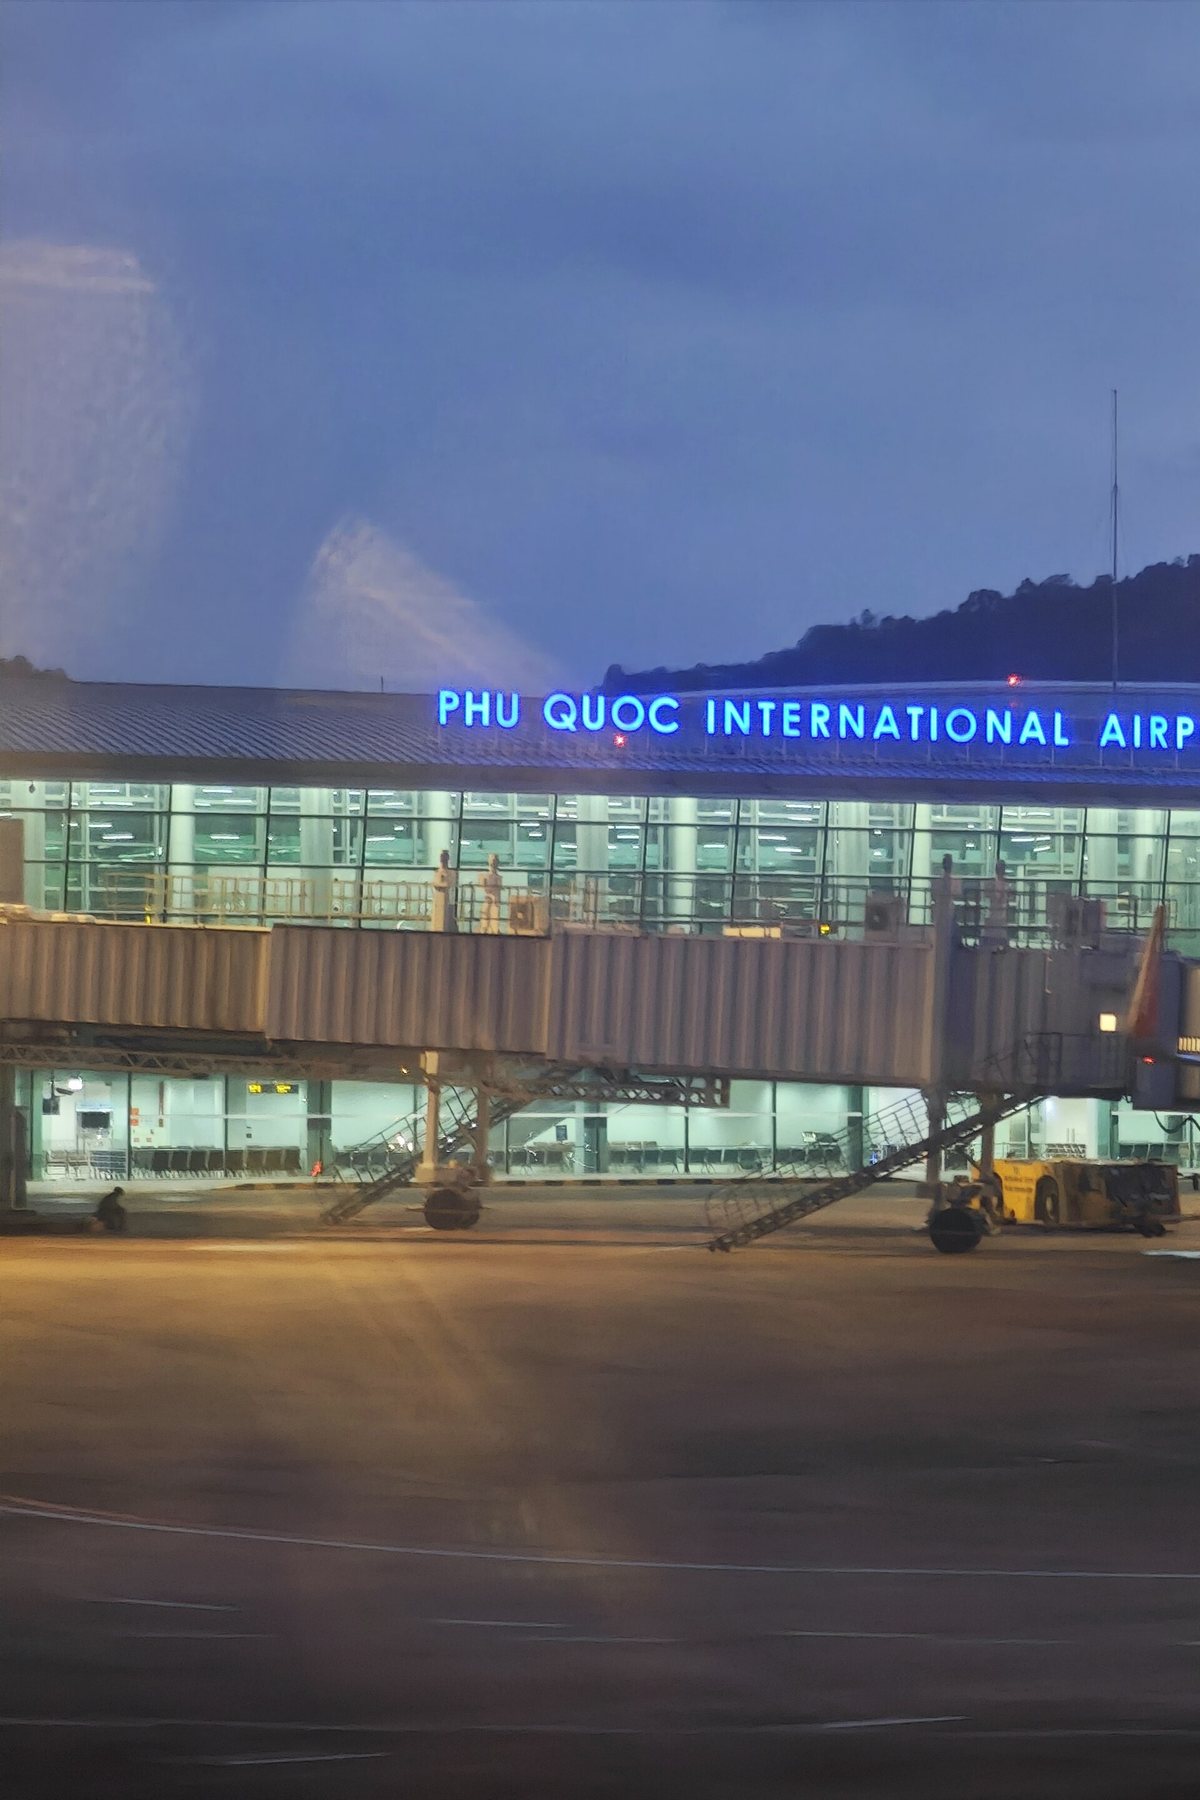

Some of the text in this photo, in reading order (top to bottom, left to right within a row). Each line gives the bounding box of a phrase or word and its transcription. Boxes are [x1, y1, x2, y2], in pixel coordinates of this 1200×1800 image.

[438, 690, 520, 728] PHU
[543, 693, 680, 733] QUOC
[706, 699, 1069, 747] INTERNATIONAL
